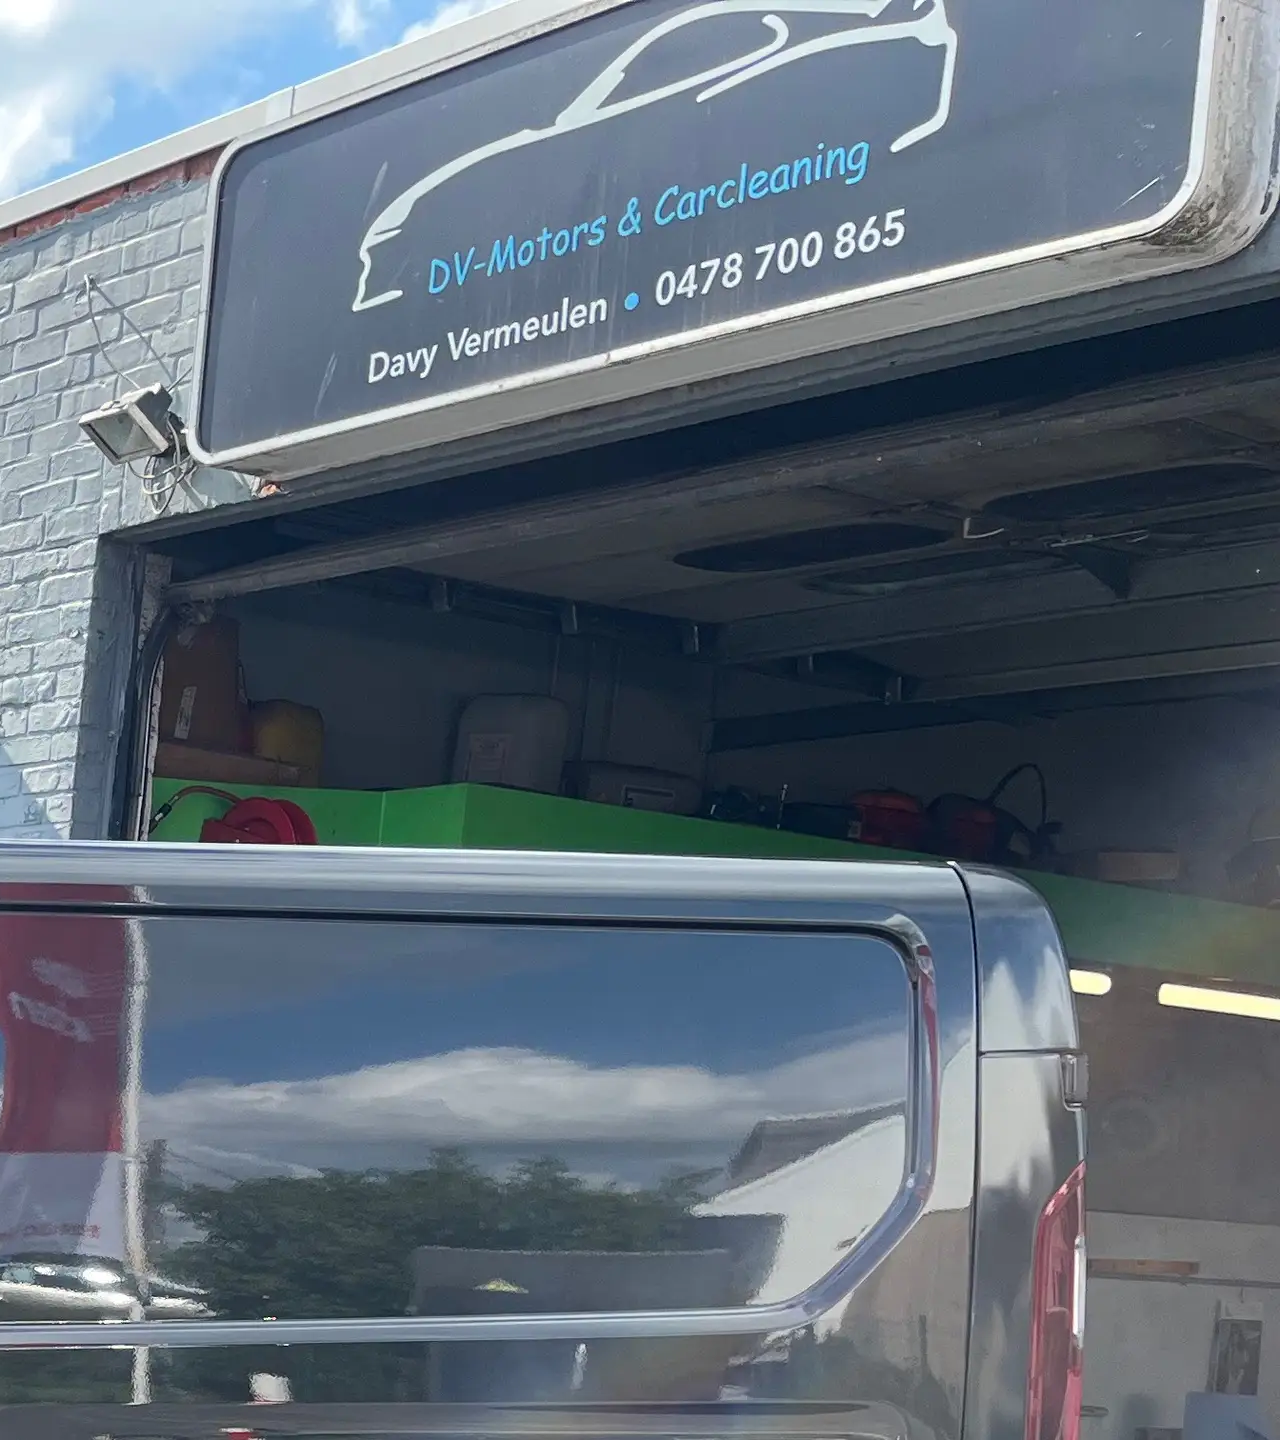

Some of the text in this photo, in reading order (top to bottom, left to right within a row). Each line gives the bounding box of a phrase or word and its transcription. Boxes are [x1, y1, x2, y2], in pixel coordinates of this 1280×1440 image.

[367, 208, 907, 384] Davy Vermeulen 0478 700 865
[428, 140, 870, 294] DV-Motors & Carcleaning
